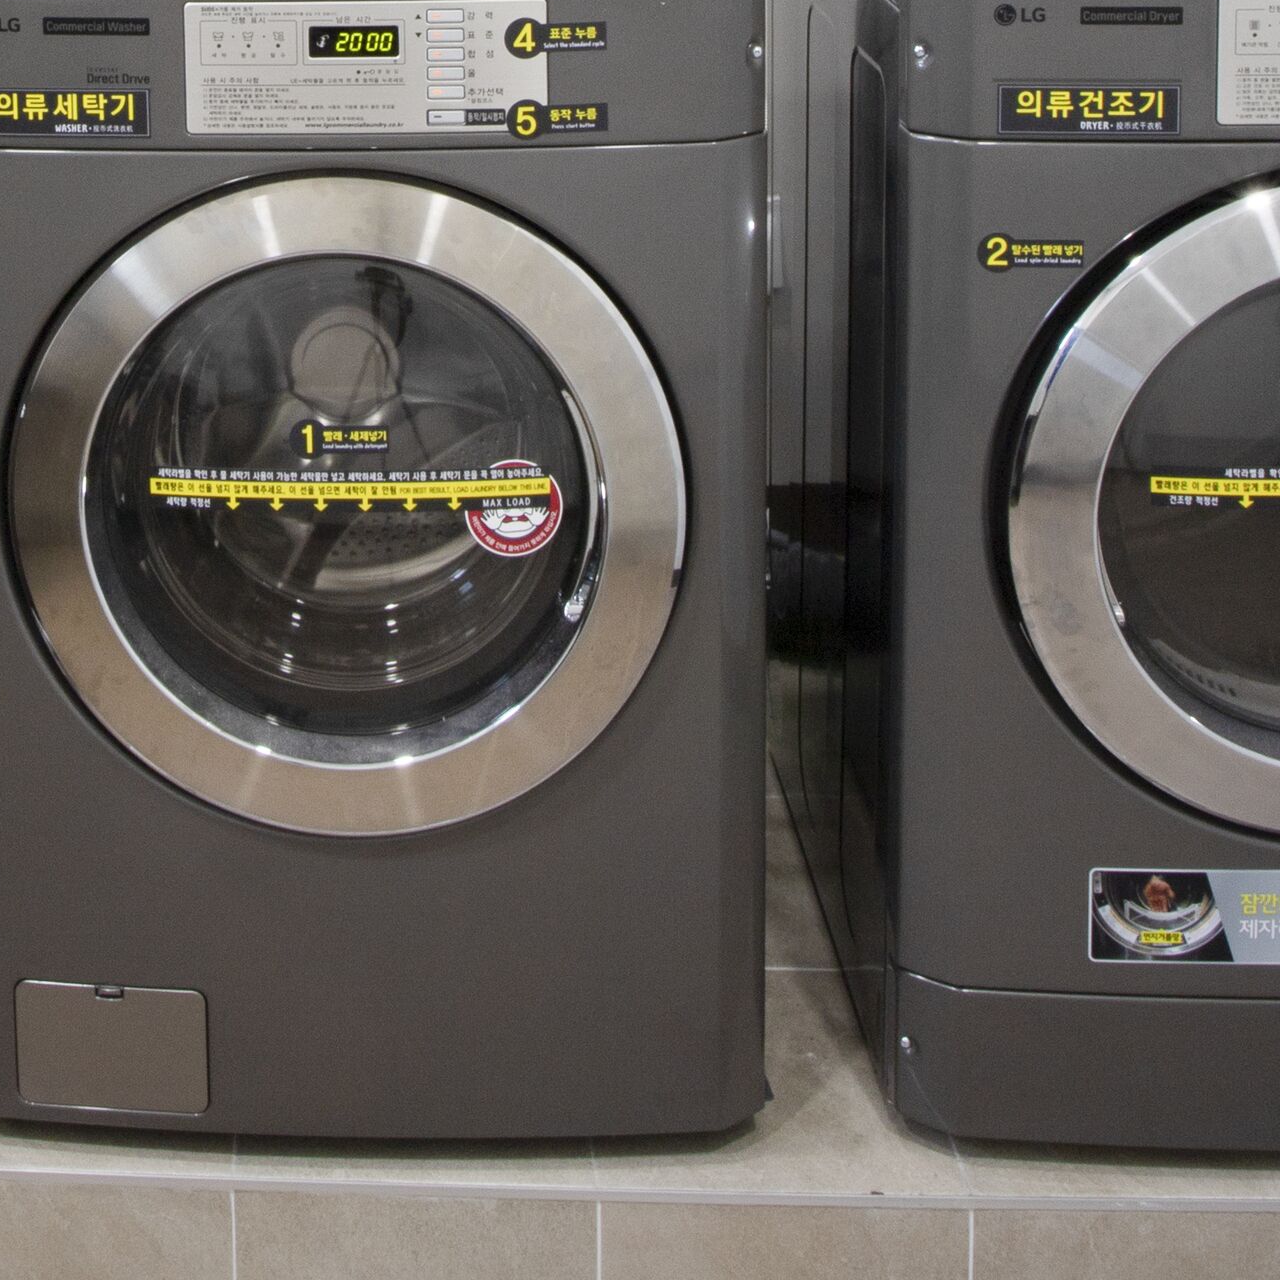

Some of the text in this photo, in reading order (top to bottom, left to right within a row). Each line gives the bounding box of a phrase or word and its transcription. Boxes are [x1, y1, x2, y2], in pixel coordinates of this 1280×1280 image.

[1021, 8, 1046, 23] LG
[1082, 11, 1180, 22] Commercial Dryer
[46, 21, 147, 33] Commercial Washer
[513, 23, 597, 52] 4 표준 누름
[87, 73, 150, 84] Direct Drive
[1016, 90, 1164, 118] 의류건조기
[515, 106, 597, 135] 5 동작 누름
[1080, 121, 1109, 130] DRYER
[55, 124, 88, 133] WASHER
[986, 236, 1082, 266] 2 탈수된 빨래 넣기
[301, 424, 313, 454] 1
[482, 497, 530, 507] MAX LOAD
[1143, 932, 1180, 942] 먼지거름망
